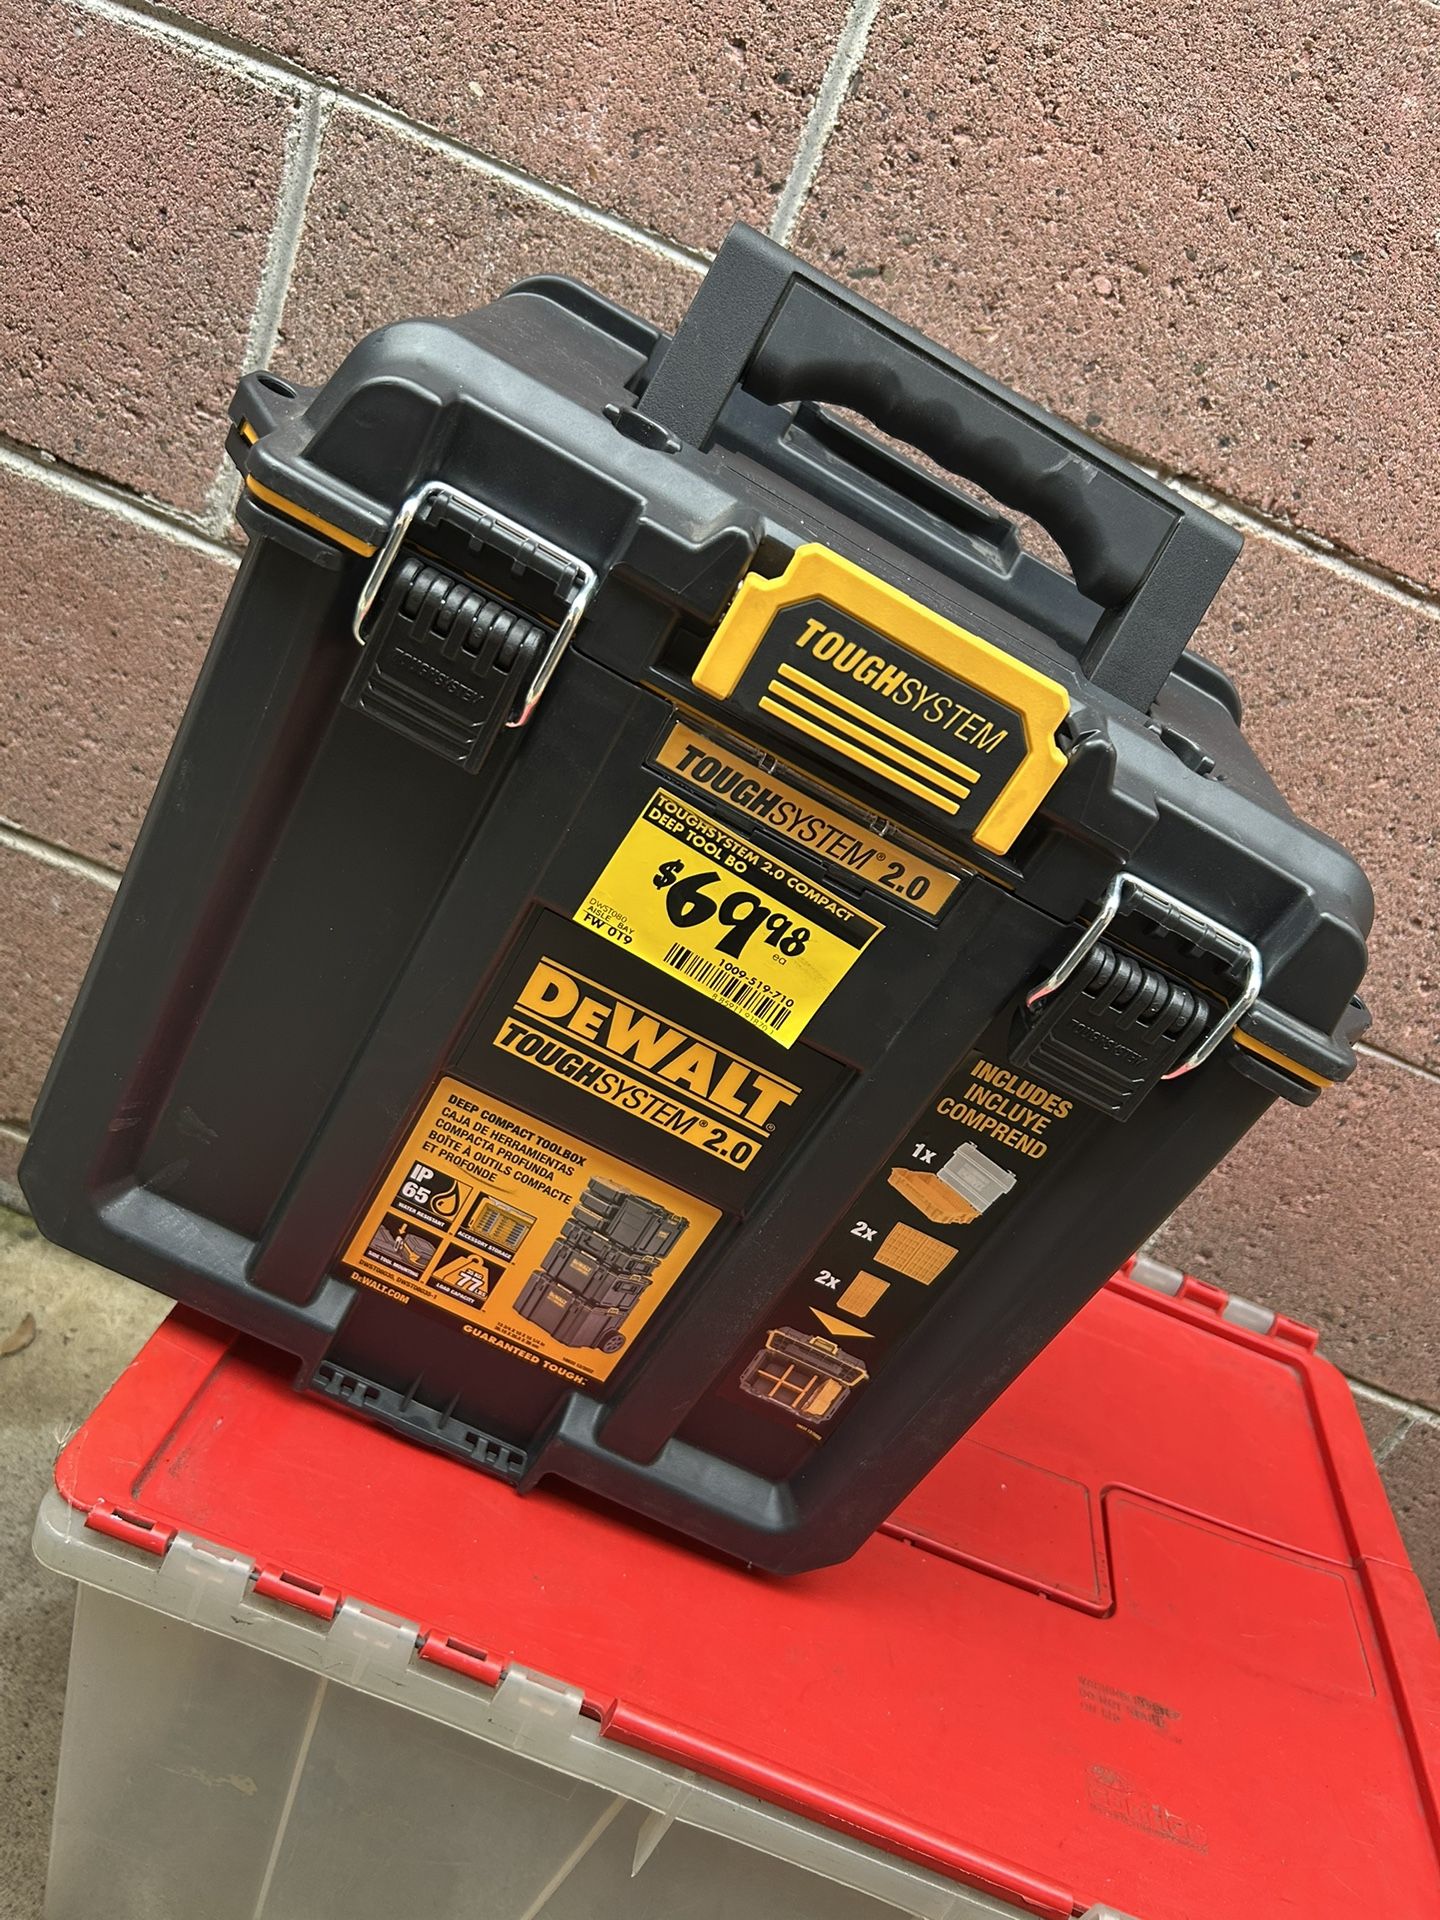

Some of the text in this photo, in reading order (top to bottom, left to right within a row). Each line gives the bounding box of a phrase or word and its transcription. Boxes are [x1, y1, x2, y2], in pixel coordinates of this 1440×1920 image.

[795, 617, 1009, 754] TOUGHSYSTEM
[648, 807, 748, 874] DEEP TOOL BO
[656, 795, 855, 923] TOUGHSYSTEM 2.0 COMPACT
[877, 861, 931, 902] 2.0
[584, 913, 606, 929] FW
[587, 906, 635, 935] AISLE BAY
[772, 953, 787, 966] ea
[719, 958, 794, 1008] 1009-519-710
[963, 1083, 1052, 1135] INCLUYE
[970, 1059, 1074, 1119] INCLUDES
[441, 1107, 575, 1176] CAJA DE HERRAMIENTAS
[448, 1094, 587, 1166] DEEP COMPACT TOOLBOX
[702, 1128, 754, 1165] 2.0
[936, 1097, 1048, 1159] COMPREND
[422, 1141, 498, 1182] ET PROFONDE
[428, 1130, 572, 1205] BOÎTE À OUTILS COMPACTE
[435, 1118, 555, 1181] COMPACTA PROFUNDA
[401, 1181, 432, 1204] 65
[410, 1164, 435, 1182] IP
[398, 1202, 446, 1228] WATER RESISTANT
[457, 1231, 513, 1260] ACCESSORY STORAGE
[436, 1282, 475, 1304] LOAD CAPACITY
[457, 1271, 483, 1292] 77
[462, 1324, 540, 1364] GUARANTEED
